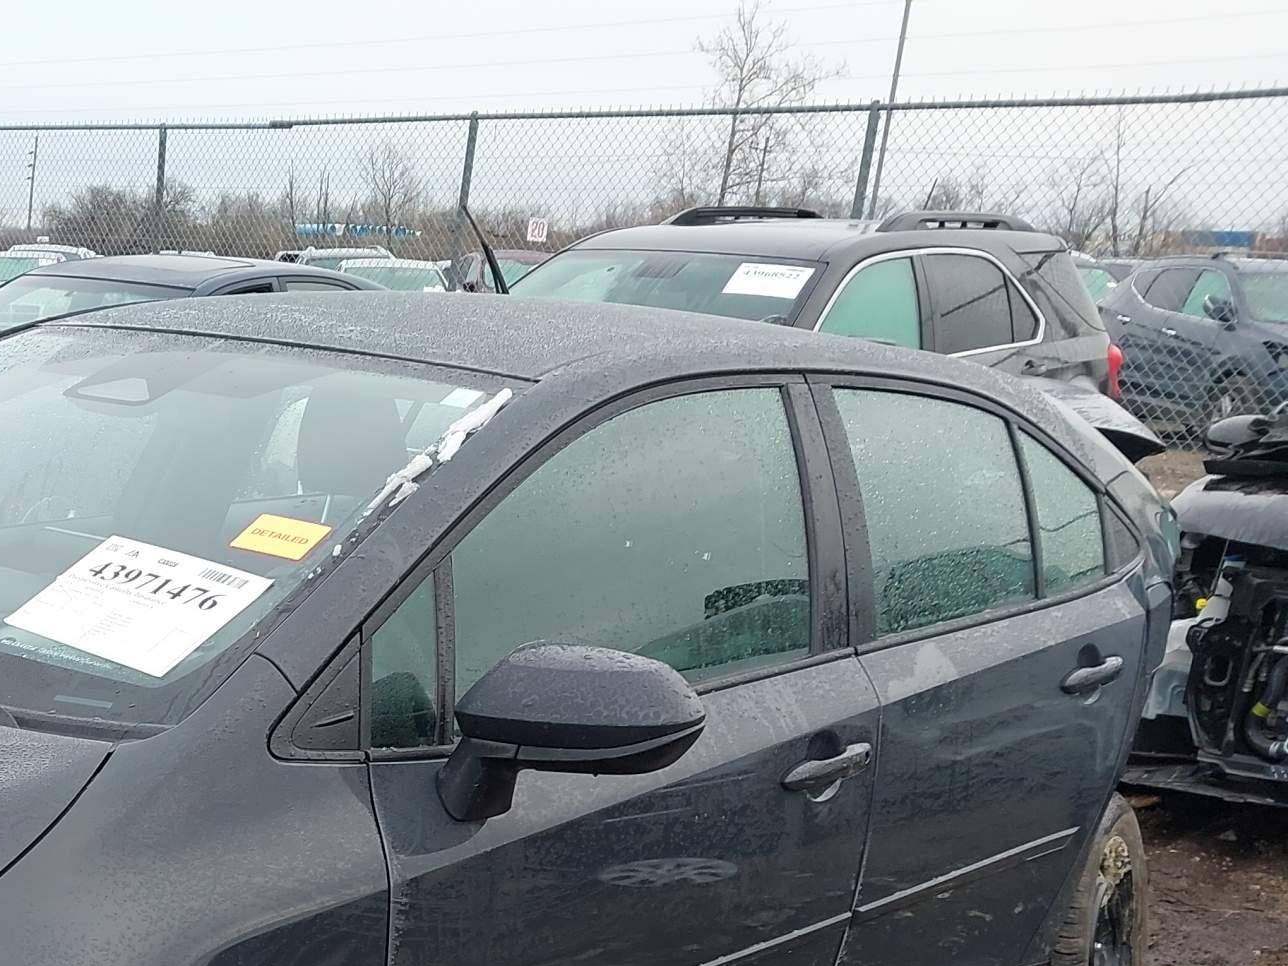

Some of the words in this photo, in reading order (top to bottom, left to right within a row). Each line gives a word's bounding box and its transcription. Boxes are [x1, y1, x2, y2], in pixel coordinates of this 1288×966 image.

[531, 220, 545, 238] 20
[251, 527, 309, 545] DETAILED
[89, 561, 227, 611] 43971476
